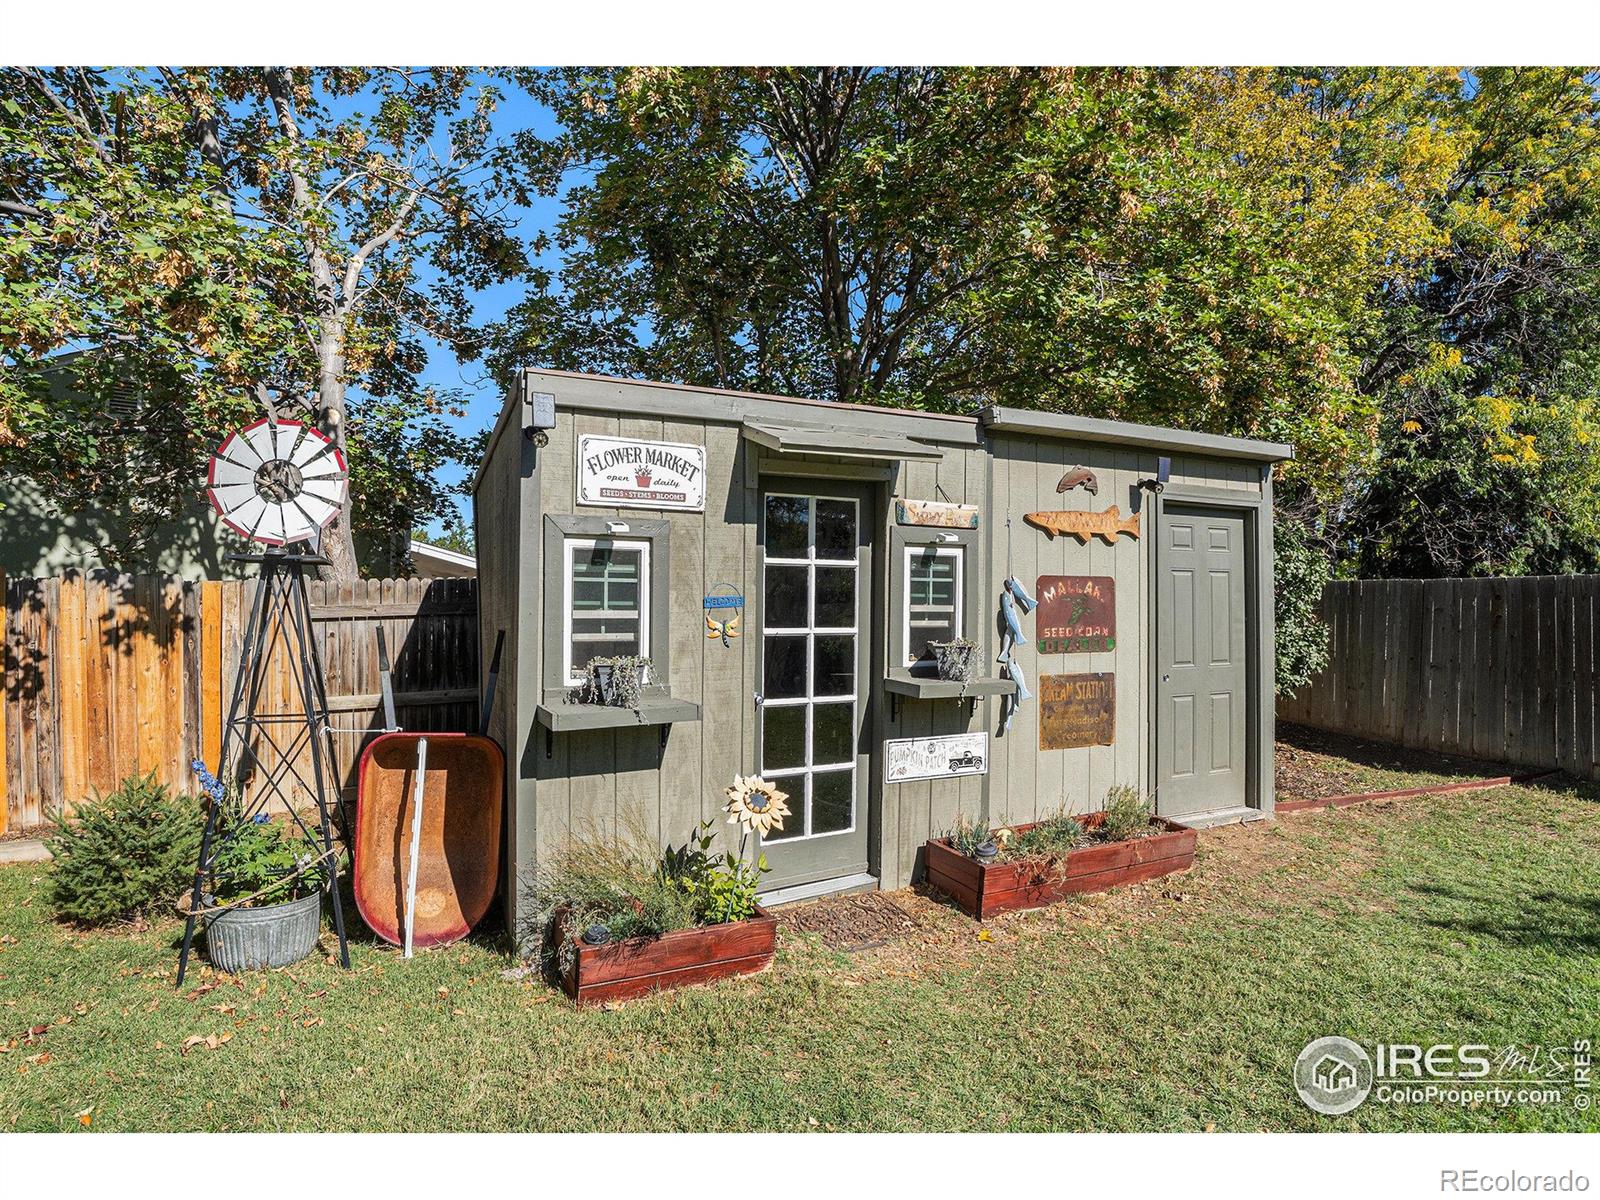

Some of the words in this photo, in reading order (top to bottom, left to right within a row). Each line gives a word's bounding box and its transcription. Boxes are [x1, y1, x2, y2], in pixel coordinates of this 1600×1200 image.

[587, 447, 642, 475] FLOWER
[645, 447, 700, 482] MARKET
[653, 478, 680, 488] daily
[602, 489, 624, 497] SEEDS
[629, 489, 652, 499] STEMS
[656, 490, 685, 501] BLOOMS
[1043, 627, 1073, 638] SEED
